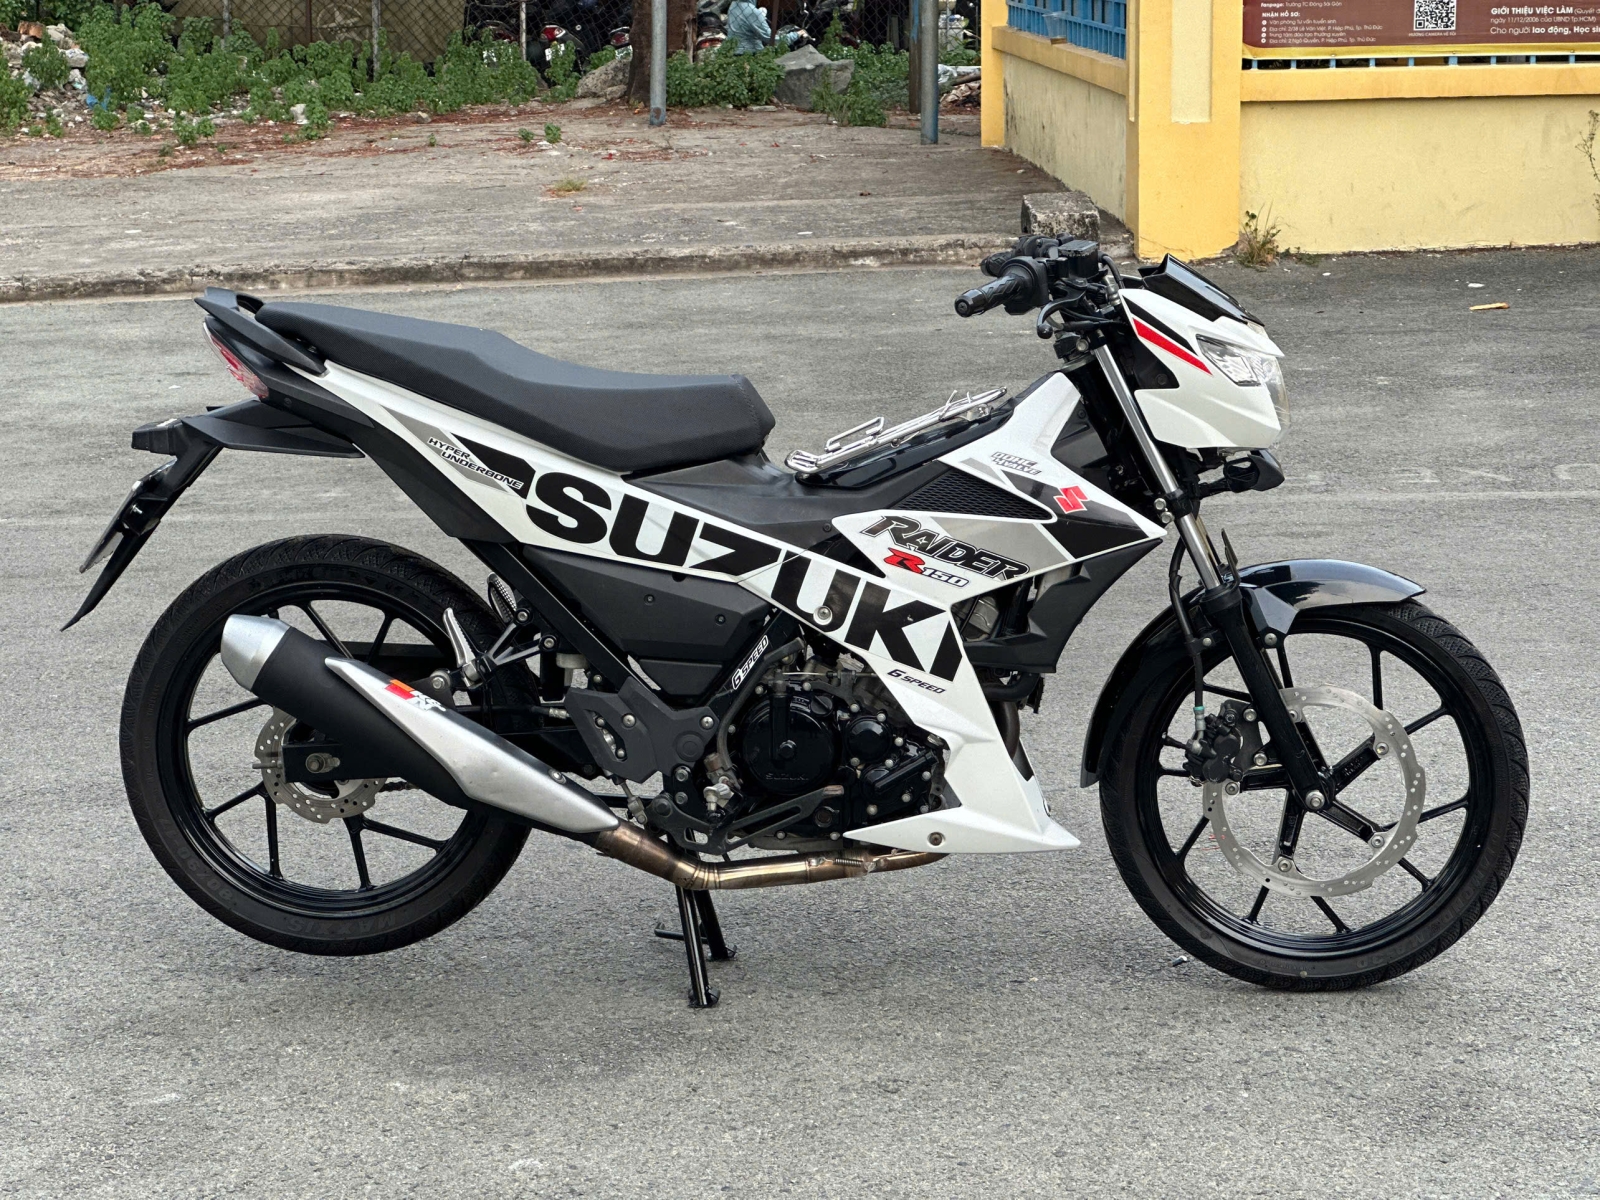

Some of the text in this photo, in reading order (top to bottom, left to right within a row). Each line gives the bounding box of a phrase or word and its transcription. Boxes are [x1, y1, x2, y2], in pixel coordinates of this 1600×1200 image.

[1491, 6, 1510, 14] GIỚI
[1512, 6, 1534, 16] THIỆU
[1536, 6, 1554, 16] VIỆC
[1556, 5, 1573, 14] LÀM
[1574, 7, 1595, 15] (Quyết
[1508, 27, 1530, 35] người
[1548, 26, 1572, 35] động,
[1574, 26, 1590, 35] Học
[428, 437, 471, 460] HYPER
[441, 451, 523, 490] UNDERBONE
[860, 516, 1030, 581] RAIDER
[526, 471, 963, 682] SUZUKI
[740, 634, 769, 680] SPEED
[900, 675, 946, 694] SPEED
[285, 911, 400, 935] MAXXIS
